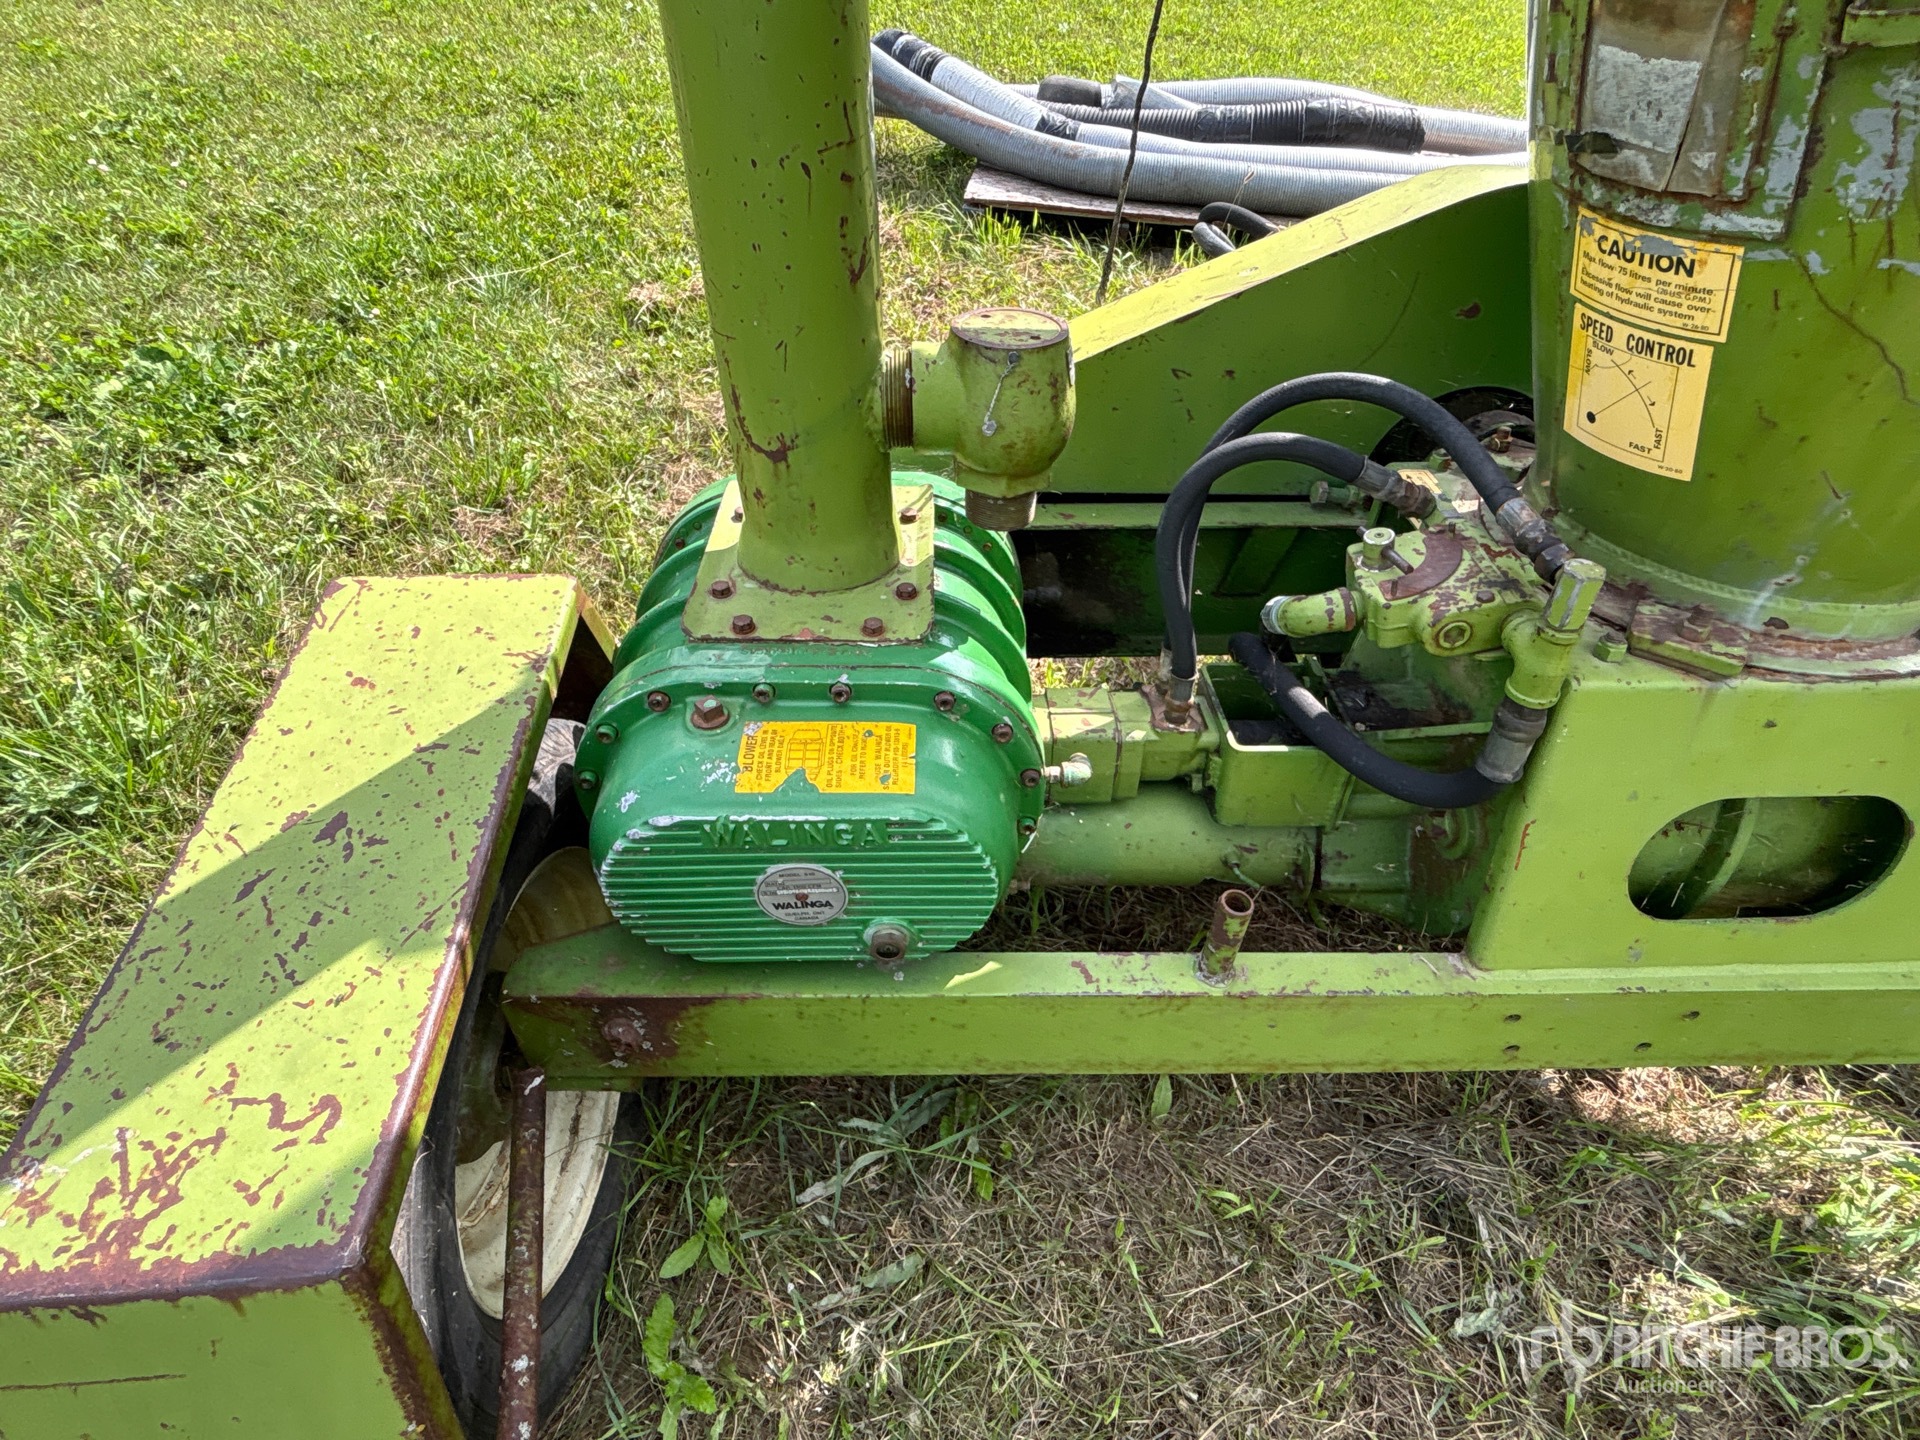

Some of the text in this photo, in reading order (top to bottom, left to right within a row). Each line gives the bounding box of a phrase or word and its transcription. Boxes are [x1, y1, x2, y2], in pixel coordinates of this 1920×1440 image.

[1597, 235, 1696, 278] CAUTION
[1618, 265, 1628, 276] 75
[1629, 269, 1652, 284] litres
[1655, 279, 1672, 288] per
[1580, 276, 1695, 321] heating of hydraulic system
[1581, 266, 1716, 315] Excessive flow will cause over-
[1579, 312, 1696, 368] SPEED CONTROL
[1592, 340, 1614, 356] SLOW
[1585, 347, 1593, 376] SLOW
[1628, 441, 1653, 455] FAST
[1653, 428, 1663, 450] FAST
[743, 735, 758, 772] BLOWER
[775, 749, 783, 773] BLOWER
[835, 745, 844, 764] CHECK
[756, 761, 764, 780] CHECK
[764, 761, 773, 782] FRONT
[702, 815, 887, 848] WALINGA
[772, 900, 834, 910] WALINGA
